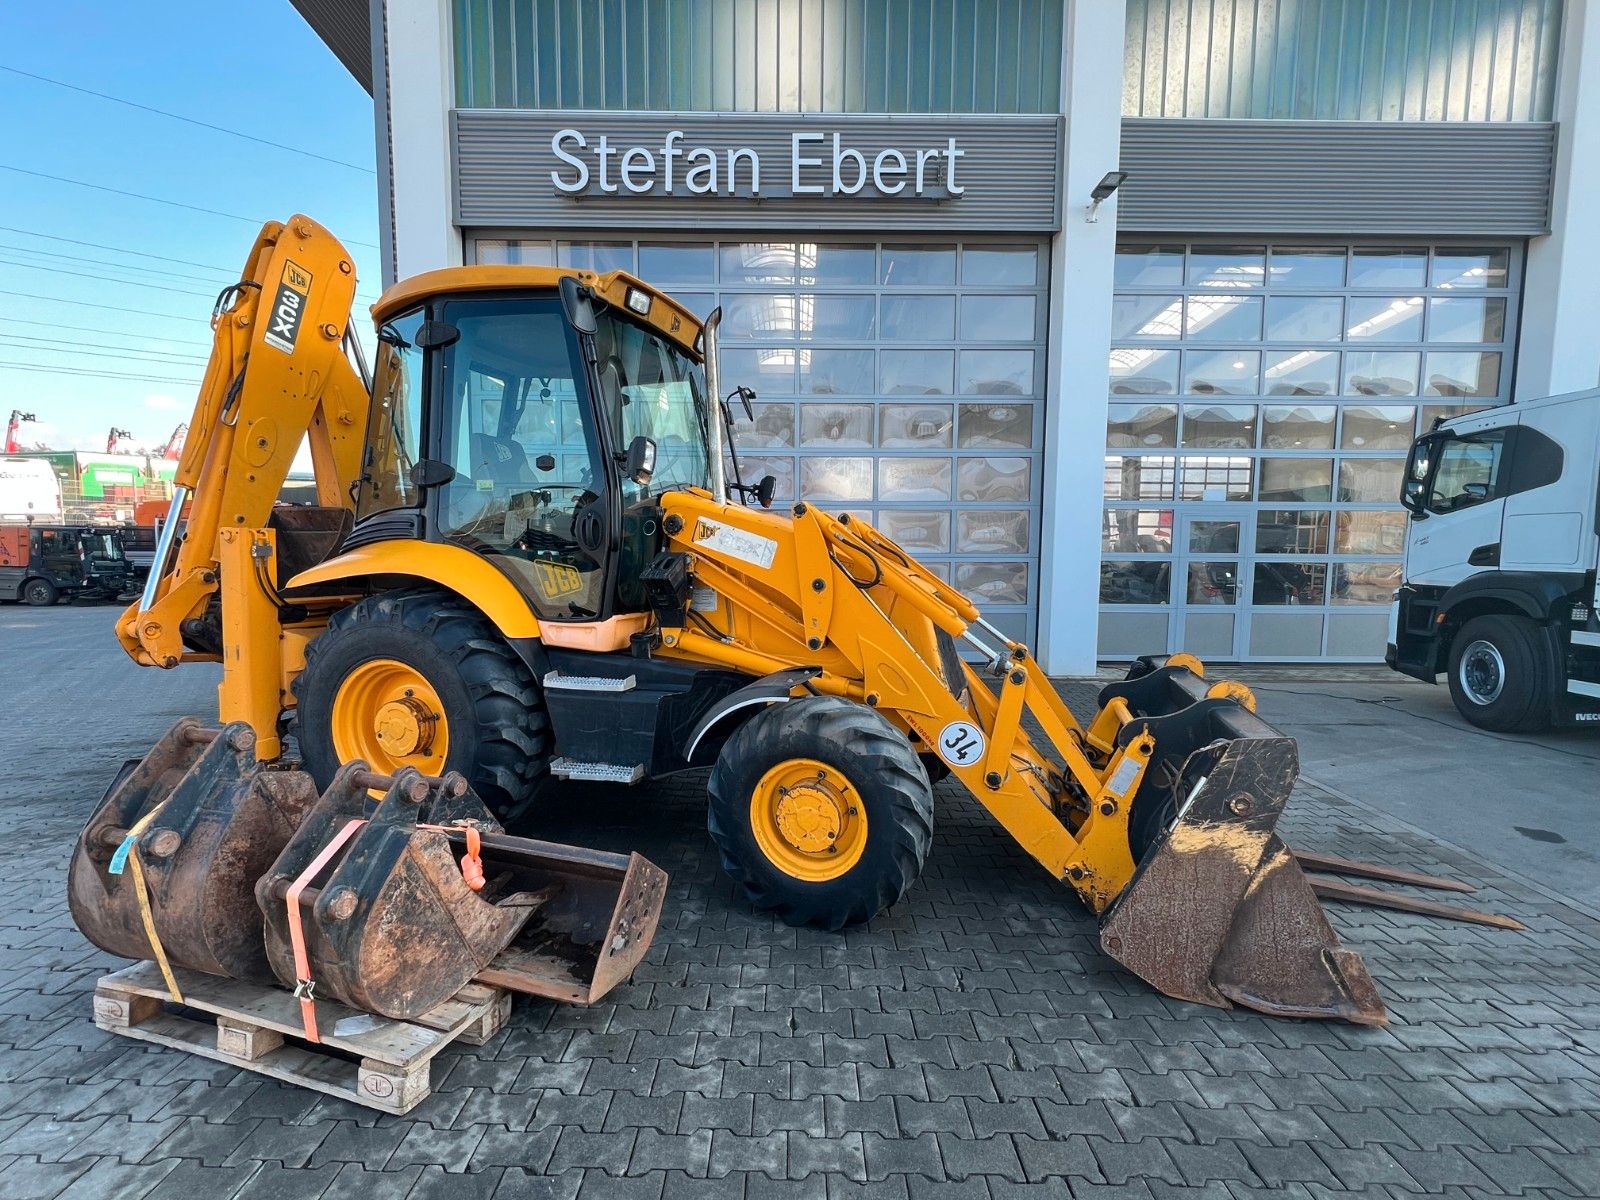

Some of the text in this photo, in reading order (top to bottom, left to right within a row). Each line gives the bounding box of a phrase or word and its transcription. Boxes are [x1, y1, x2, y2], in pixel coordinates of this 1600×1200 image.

[550, 128, 965, 195] Stefan Ebert
[289, 267, 307, 288] JCB
[272, 290, 300, 339] 3CX
[542, 562, 580, 597] JCB
[945, 727, 978, 761] 34
